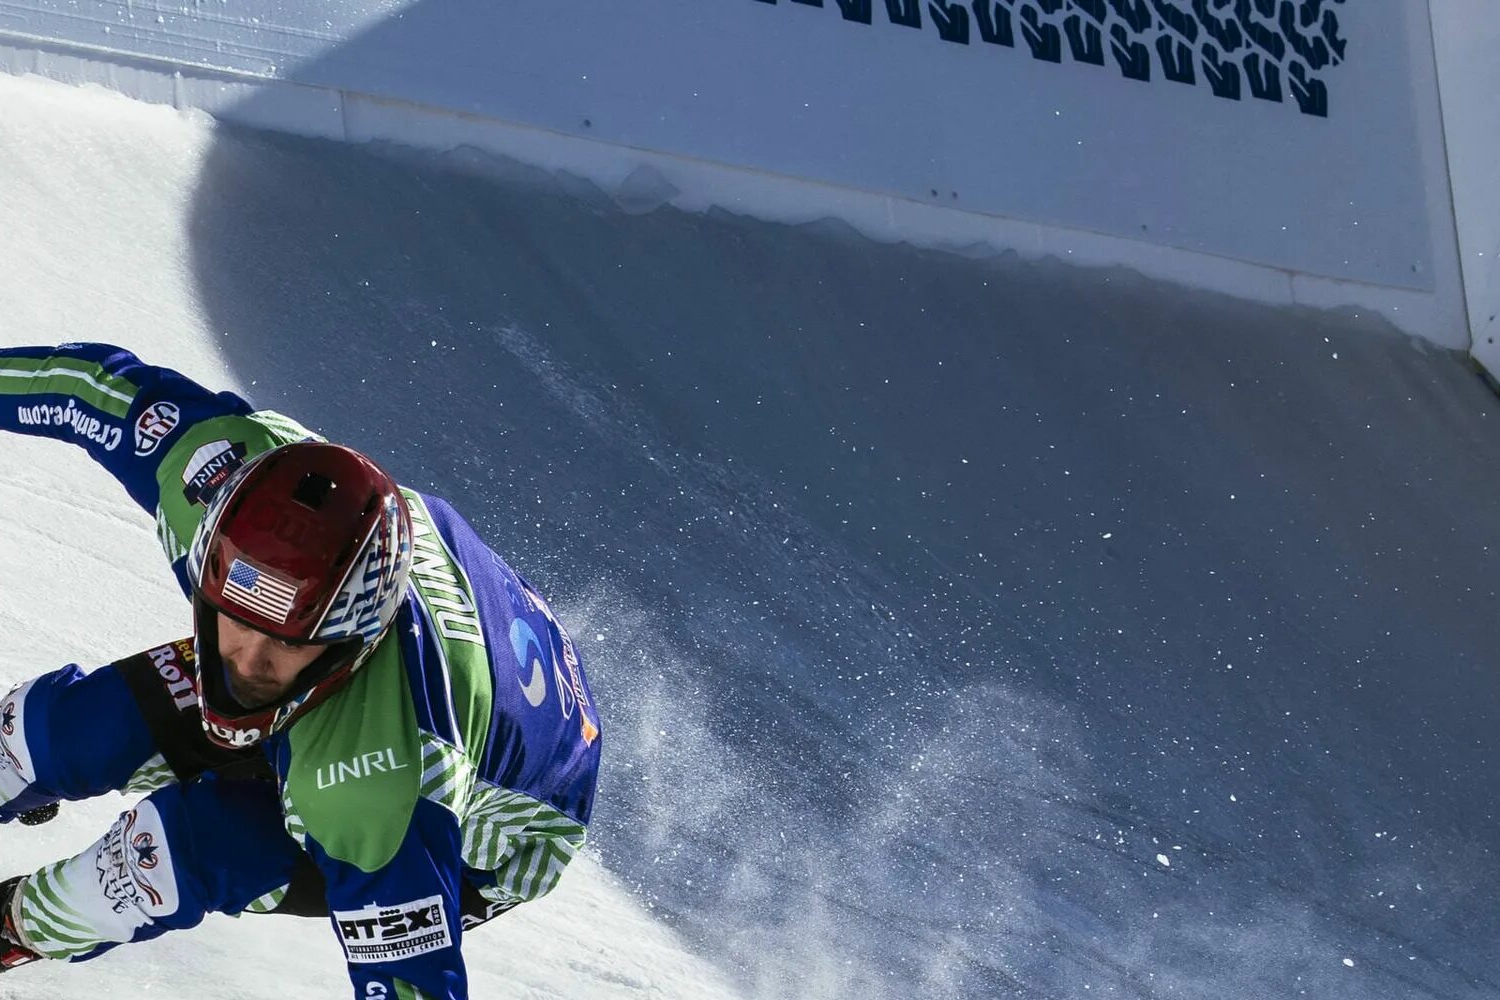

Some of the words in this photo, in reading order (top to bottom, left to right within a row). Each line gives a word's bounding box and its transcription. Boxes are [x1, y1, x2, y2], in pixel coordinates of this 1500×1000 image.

[191, 449, 237, 489] UNRL
[316, 748, 409, 790] UNRL
[111, 823, 145, 906] RIENDS
